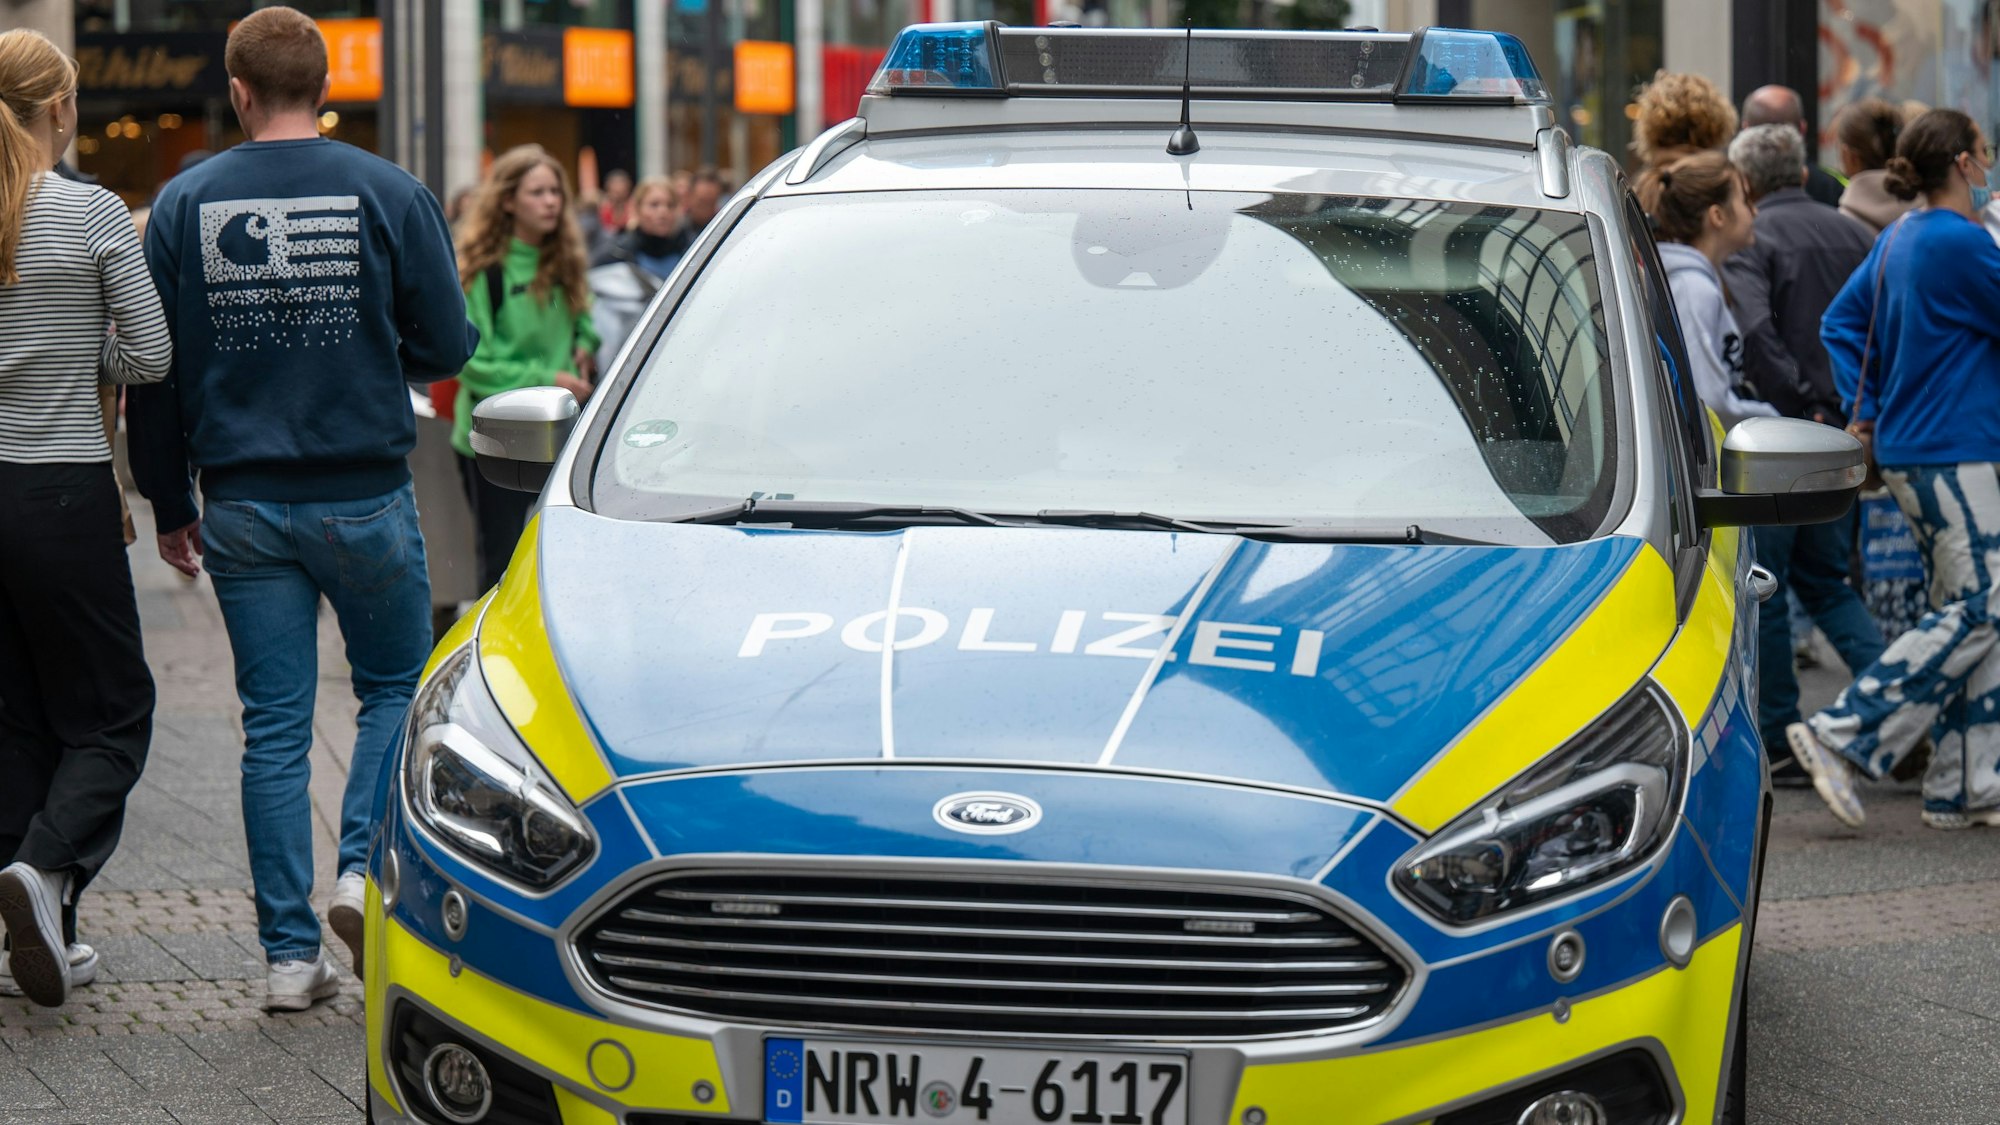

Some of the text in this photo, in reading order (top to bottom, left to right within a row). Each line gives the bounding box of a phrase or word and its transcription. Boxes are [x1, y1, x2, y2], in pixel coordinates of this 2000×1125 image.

[736, 606, 1325, 678] POLIZEI
[961, 802, 1015, 823] Ford
[776, 1089, 792, 1108] D
[805, 1050, 1184, 1125] NRW 4-6117
